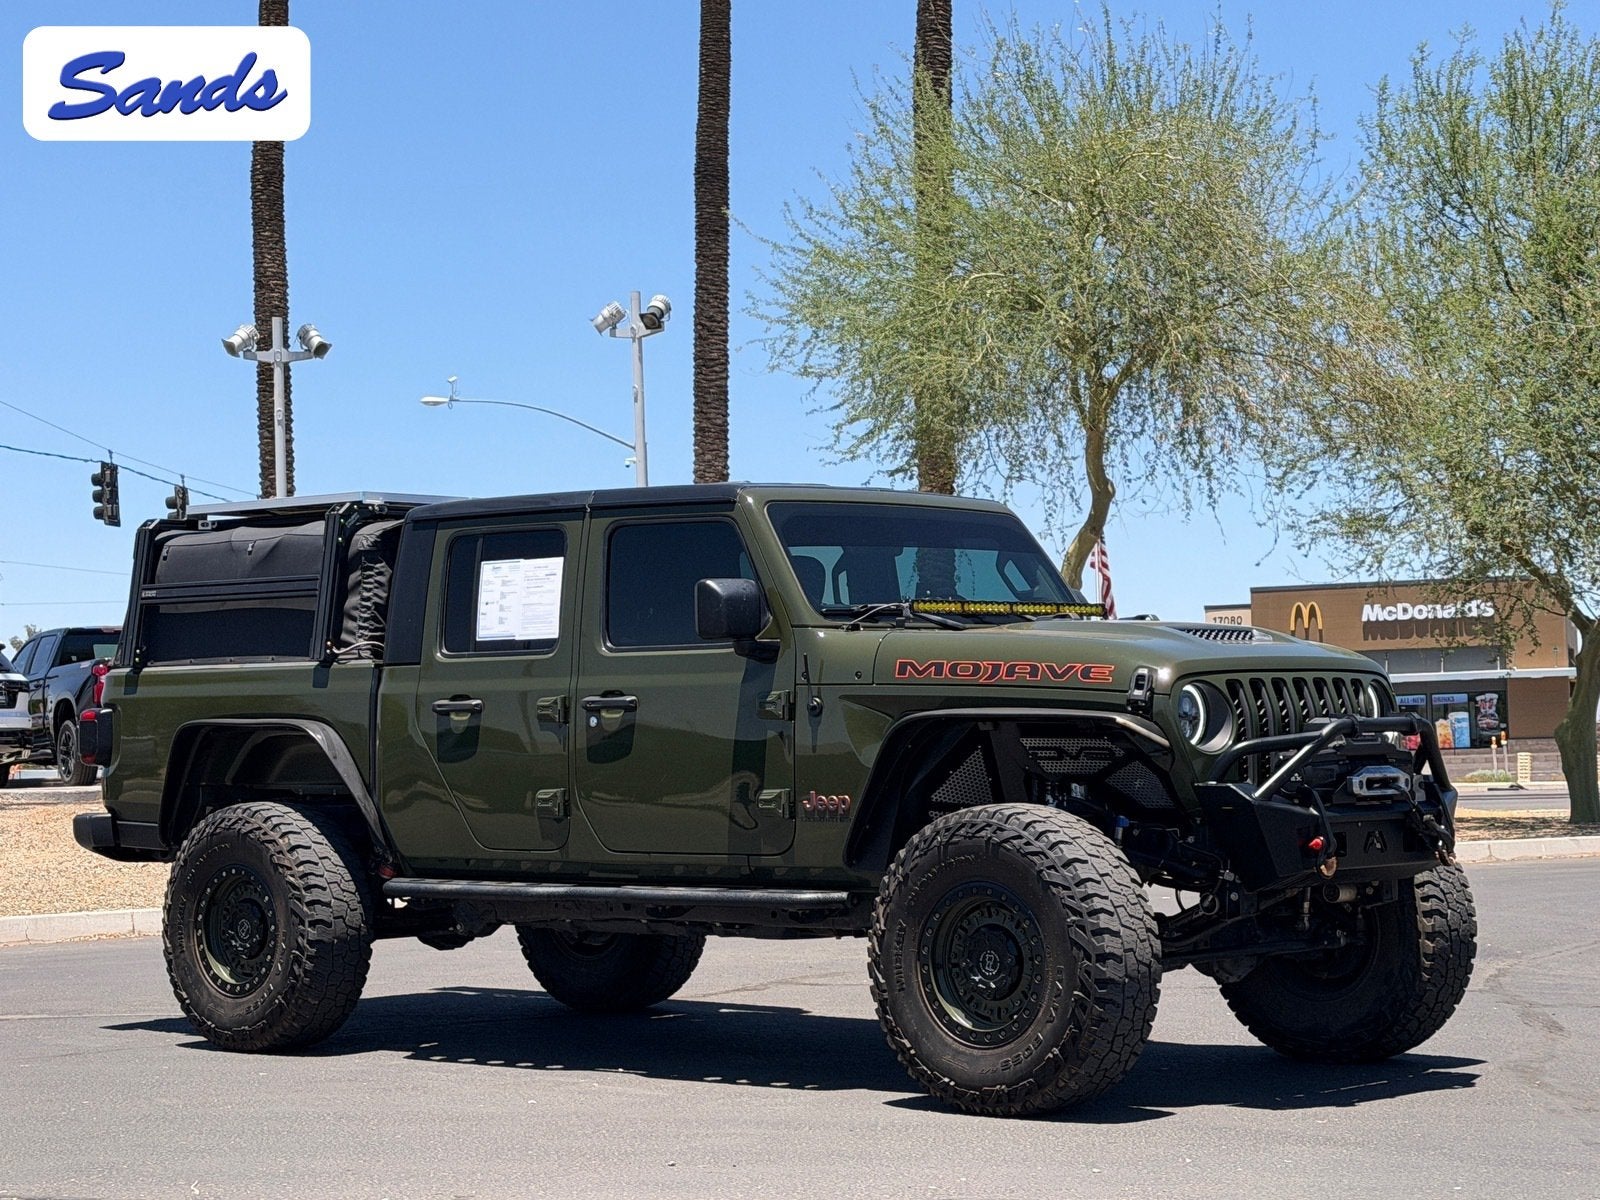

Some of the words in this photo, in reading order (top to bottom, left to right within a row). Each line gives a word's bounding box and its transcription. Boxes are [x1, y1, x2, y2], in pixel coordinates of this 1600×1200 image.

[1213, 616, 1243, 625] 17080
[1362, 600, 1495, 621] McDonald's
[895, 659, 1115, 683] MOJAVE
[802, 790, 851, 816] Jeep
